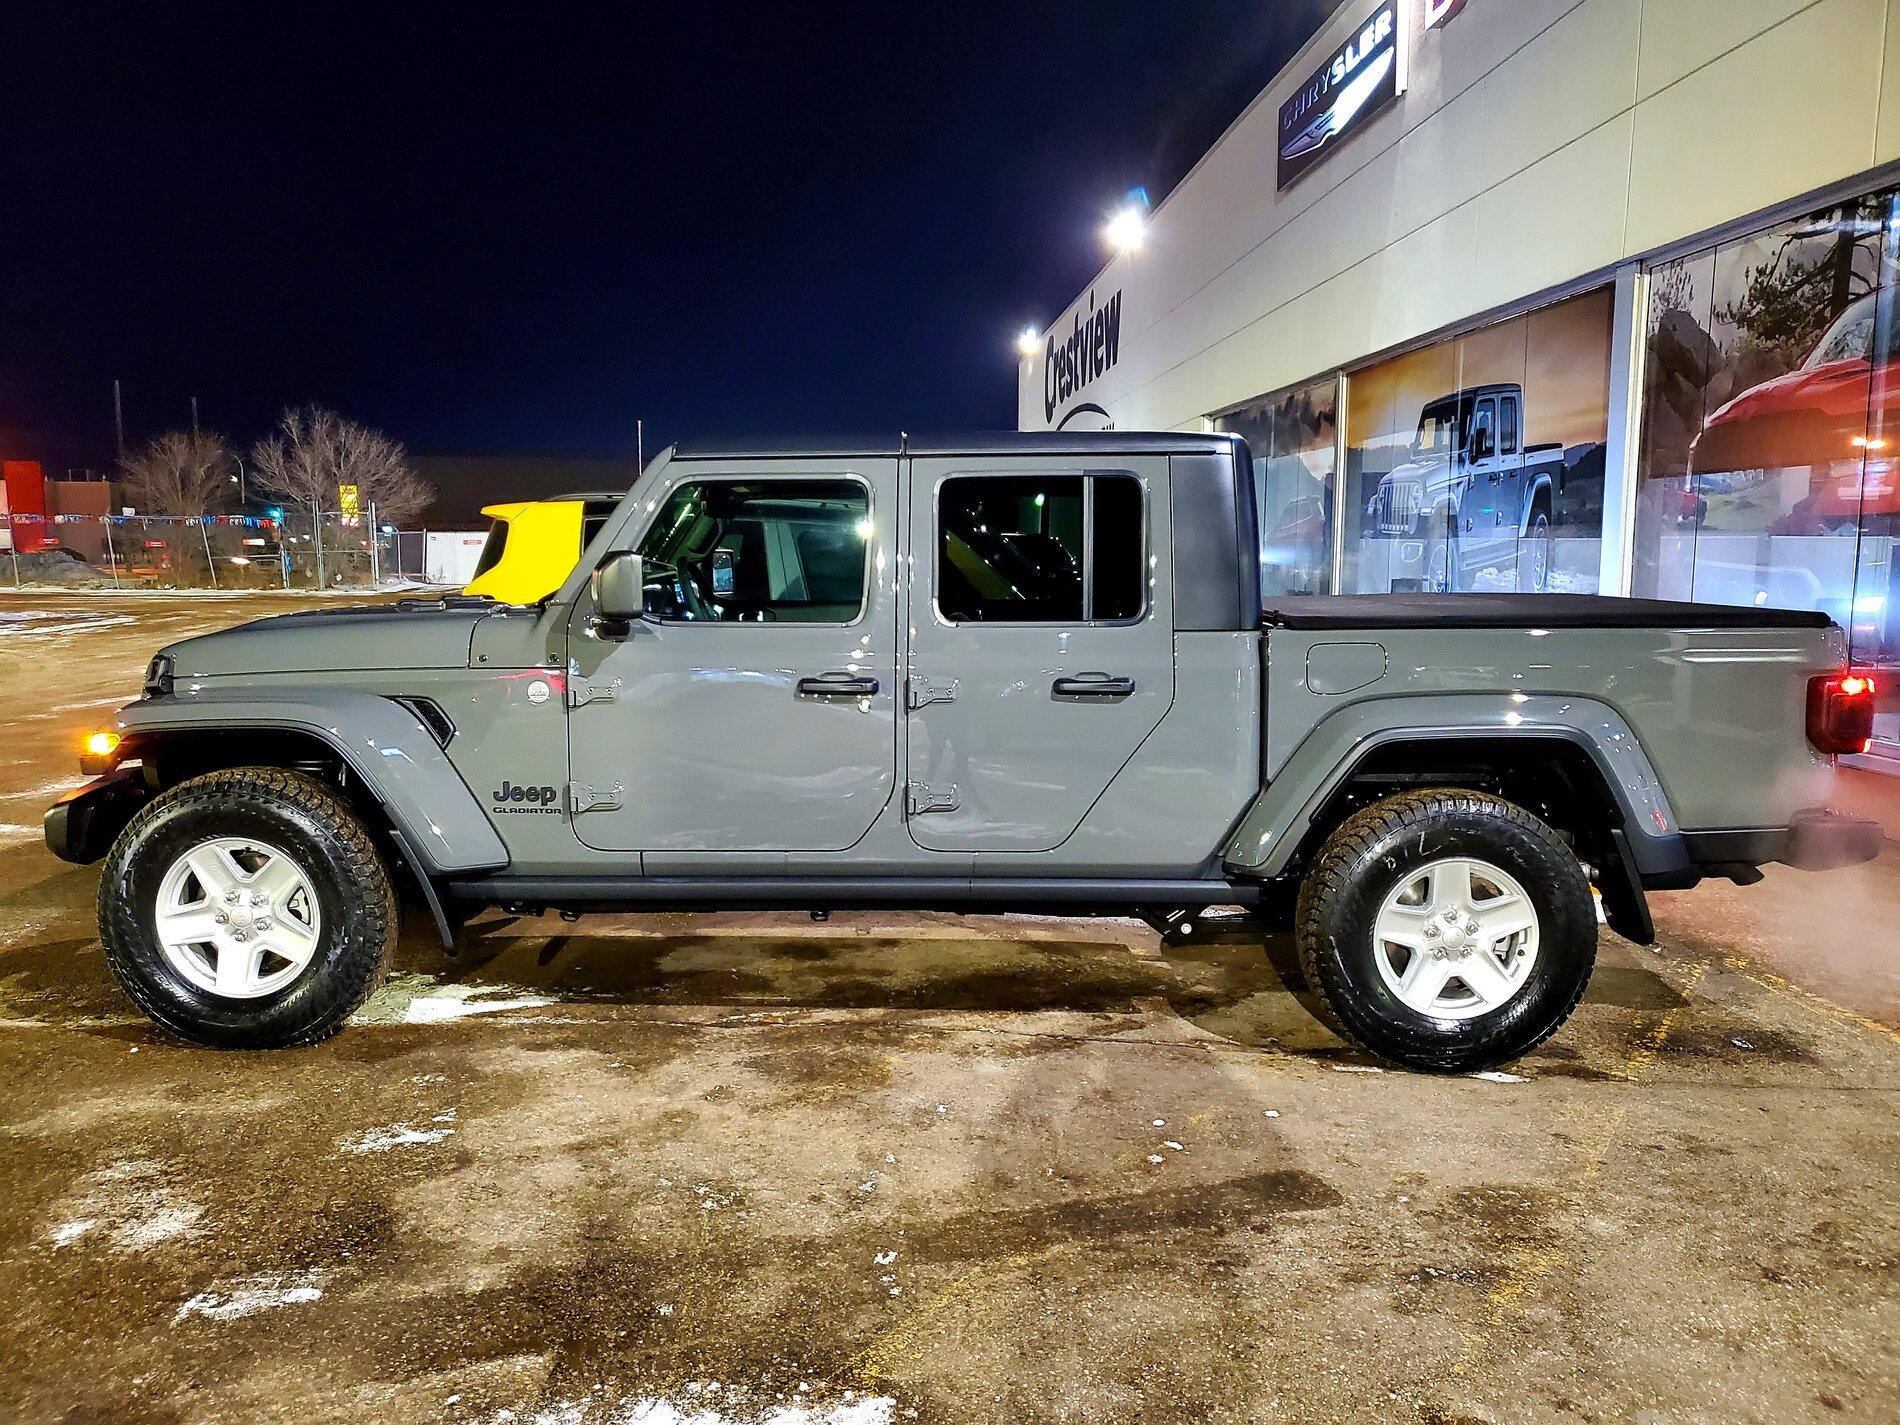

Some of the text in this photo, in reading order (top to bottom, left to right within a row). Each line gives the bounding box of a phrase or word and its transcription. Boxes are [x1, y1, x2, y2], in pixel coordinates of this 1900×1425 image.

[1283, 9, 1392, 130] CHRYSLER
[1045, 287, 1122, 424] Crestview
[492, 806, 562, 815] GLADIATOR
[493, 780, 556, 806] Jeep
